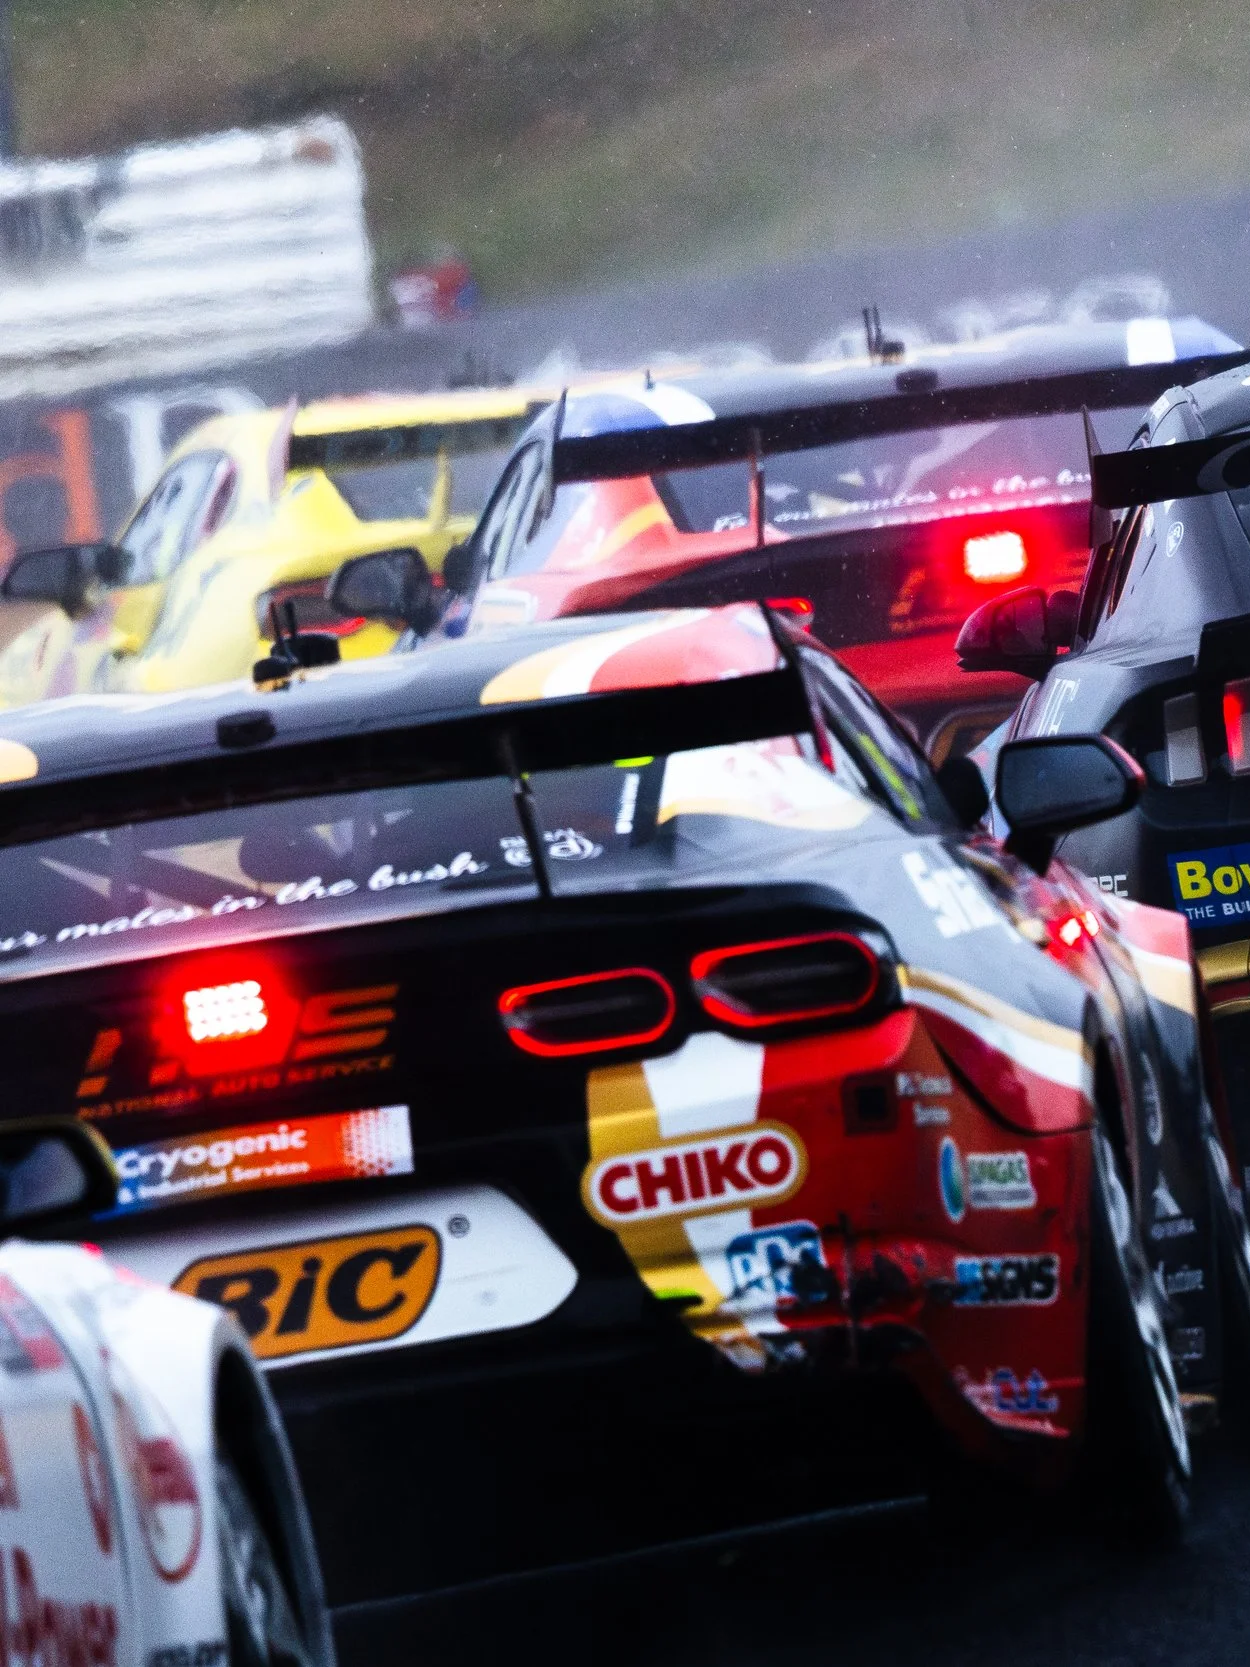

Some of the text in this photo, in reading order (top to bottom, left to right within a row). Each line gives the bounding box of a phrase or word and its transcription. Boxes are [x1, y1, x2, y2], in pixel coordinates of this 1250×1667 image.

[276, 876, 358, 907] the
[367, 851, 490, 891] bush
[1184, 904, 1217, 921] THE
[115, 1123, 308, 1180] Cryogenic
[597, 1134, 793, 1214] CHIKO
